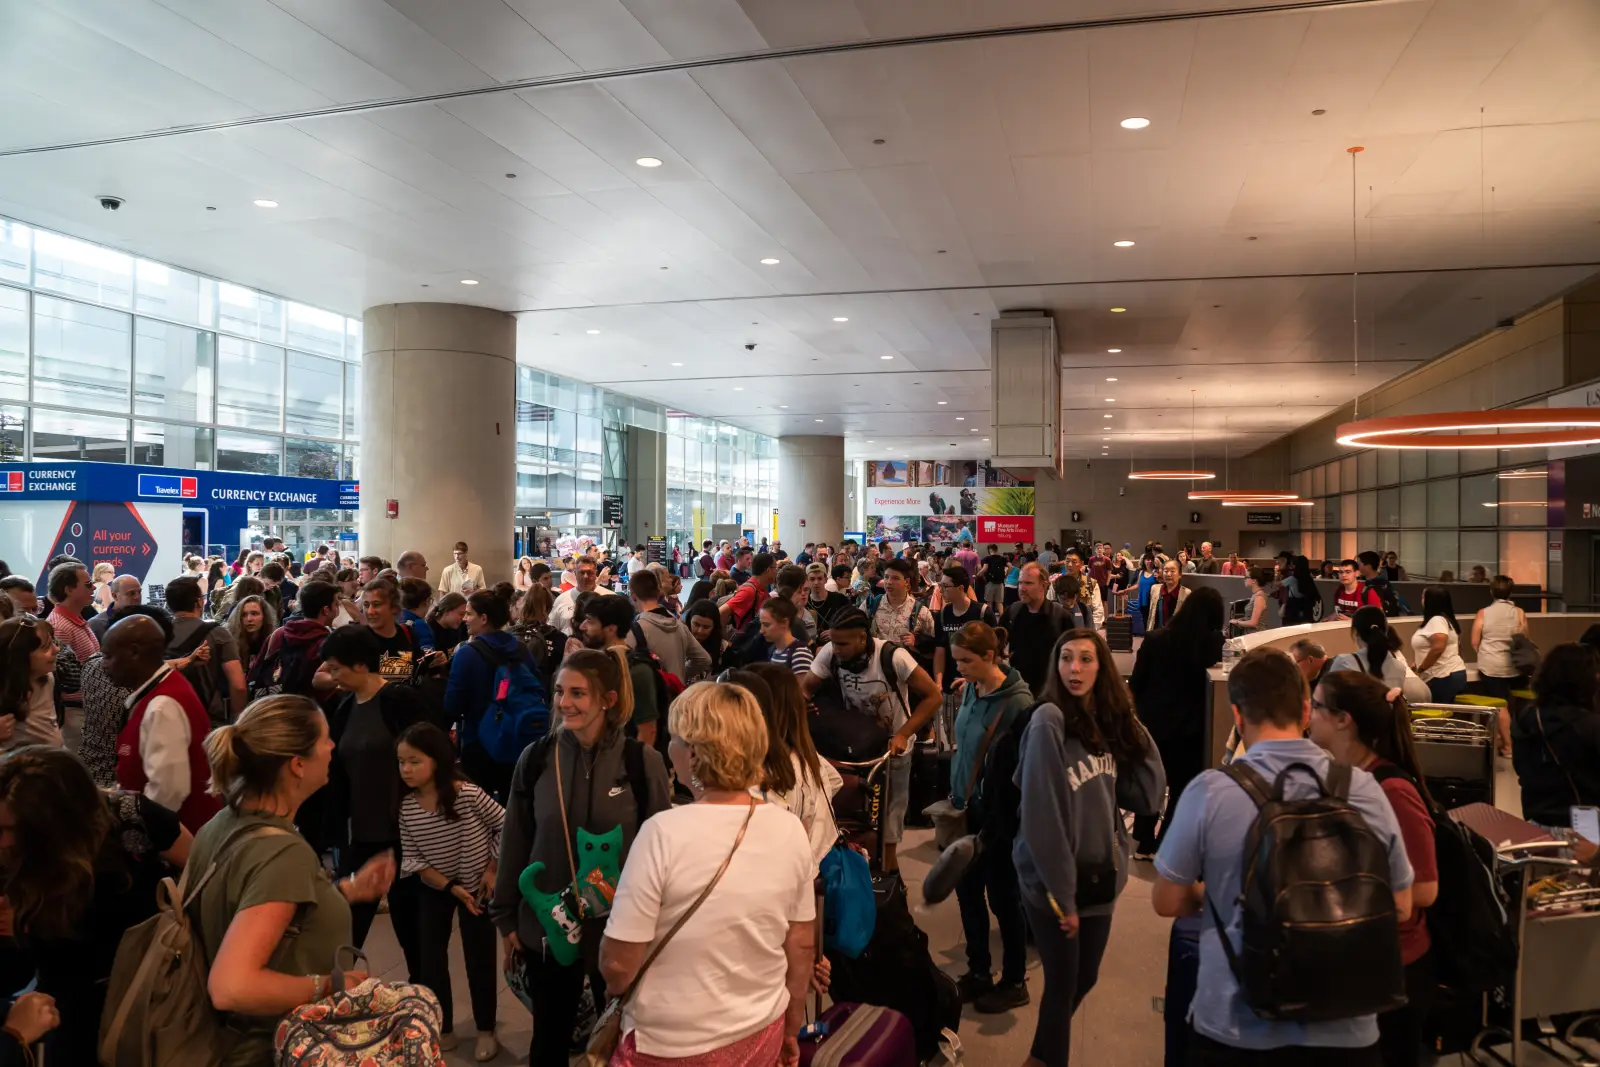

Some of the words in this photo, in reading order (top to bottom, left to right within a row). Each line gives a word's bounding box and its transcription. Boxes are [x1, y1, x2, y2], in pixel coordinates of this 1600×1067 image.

[29, 470, 76, 479] CURRENCY
[29, 482, 77, 491] EXCHANGE
[155, 485, 180, 495] Travelex
[211, 488, 266, 501] CURRENCY
[268, 491, 318, 503] EXCHANGE
[874, 498, 905, 506] Experience
[93, 529, 107, 541] All
[109, 532, 132, 542] your
[93, 545, 136, 556] currency
